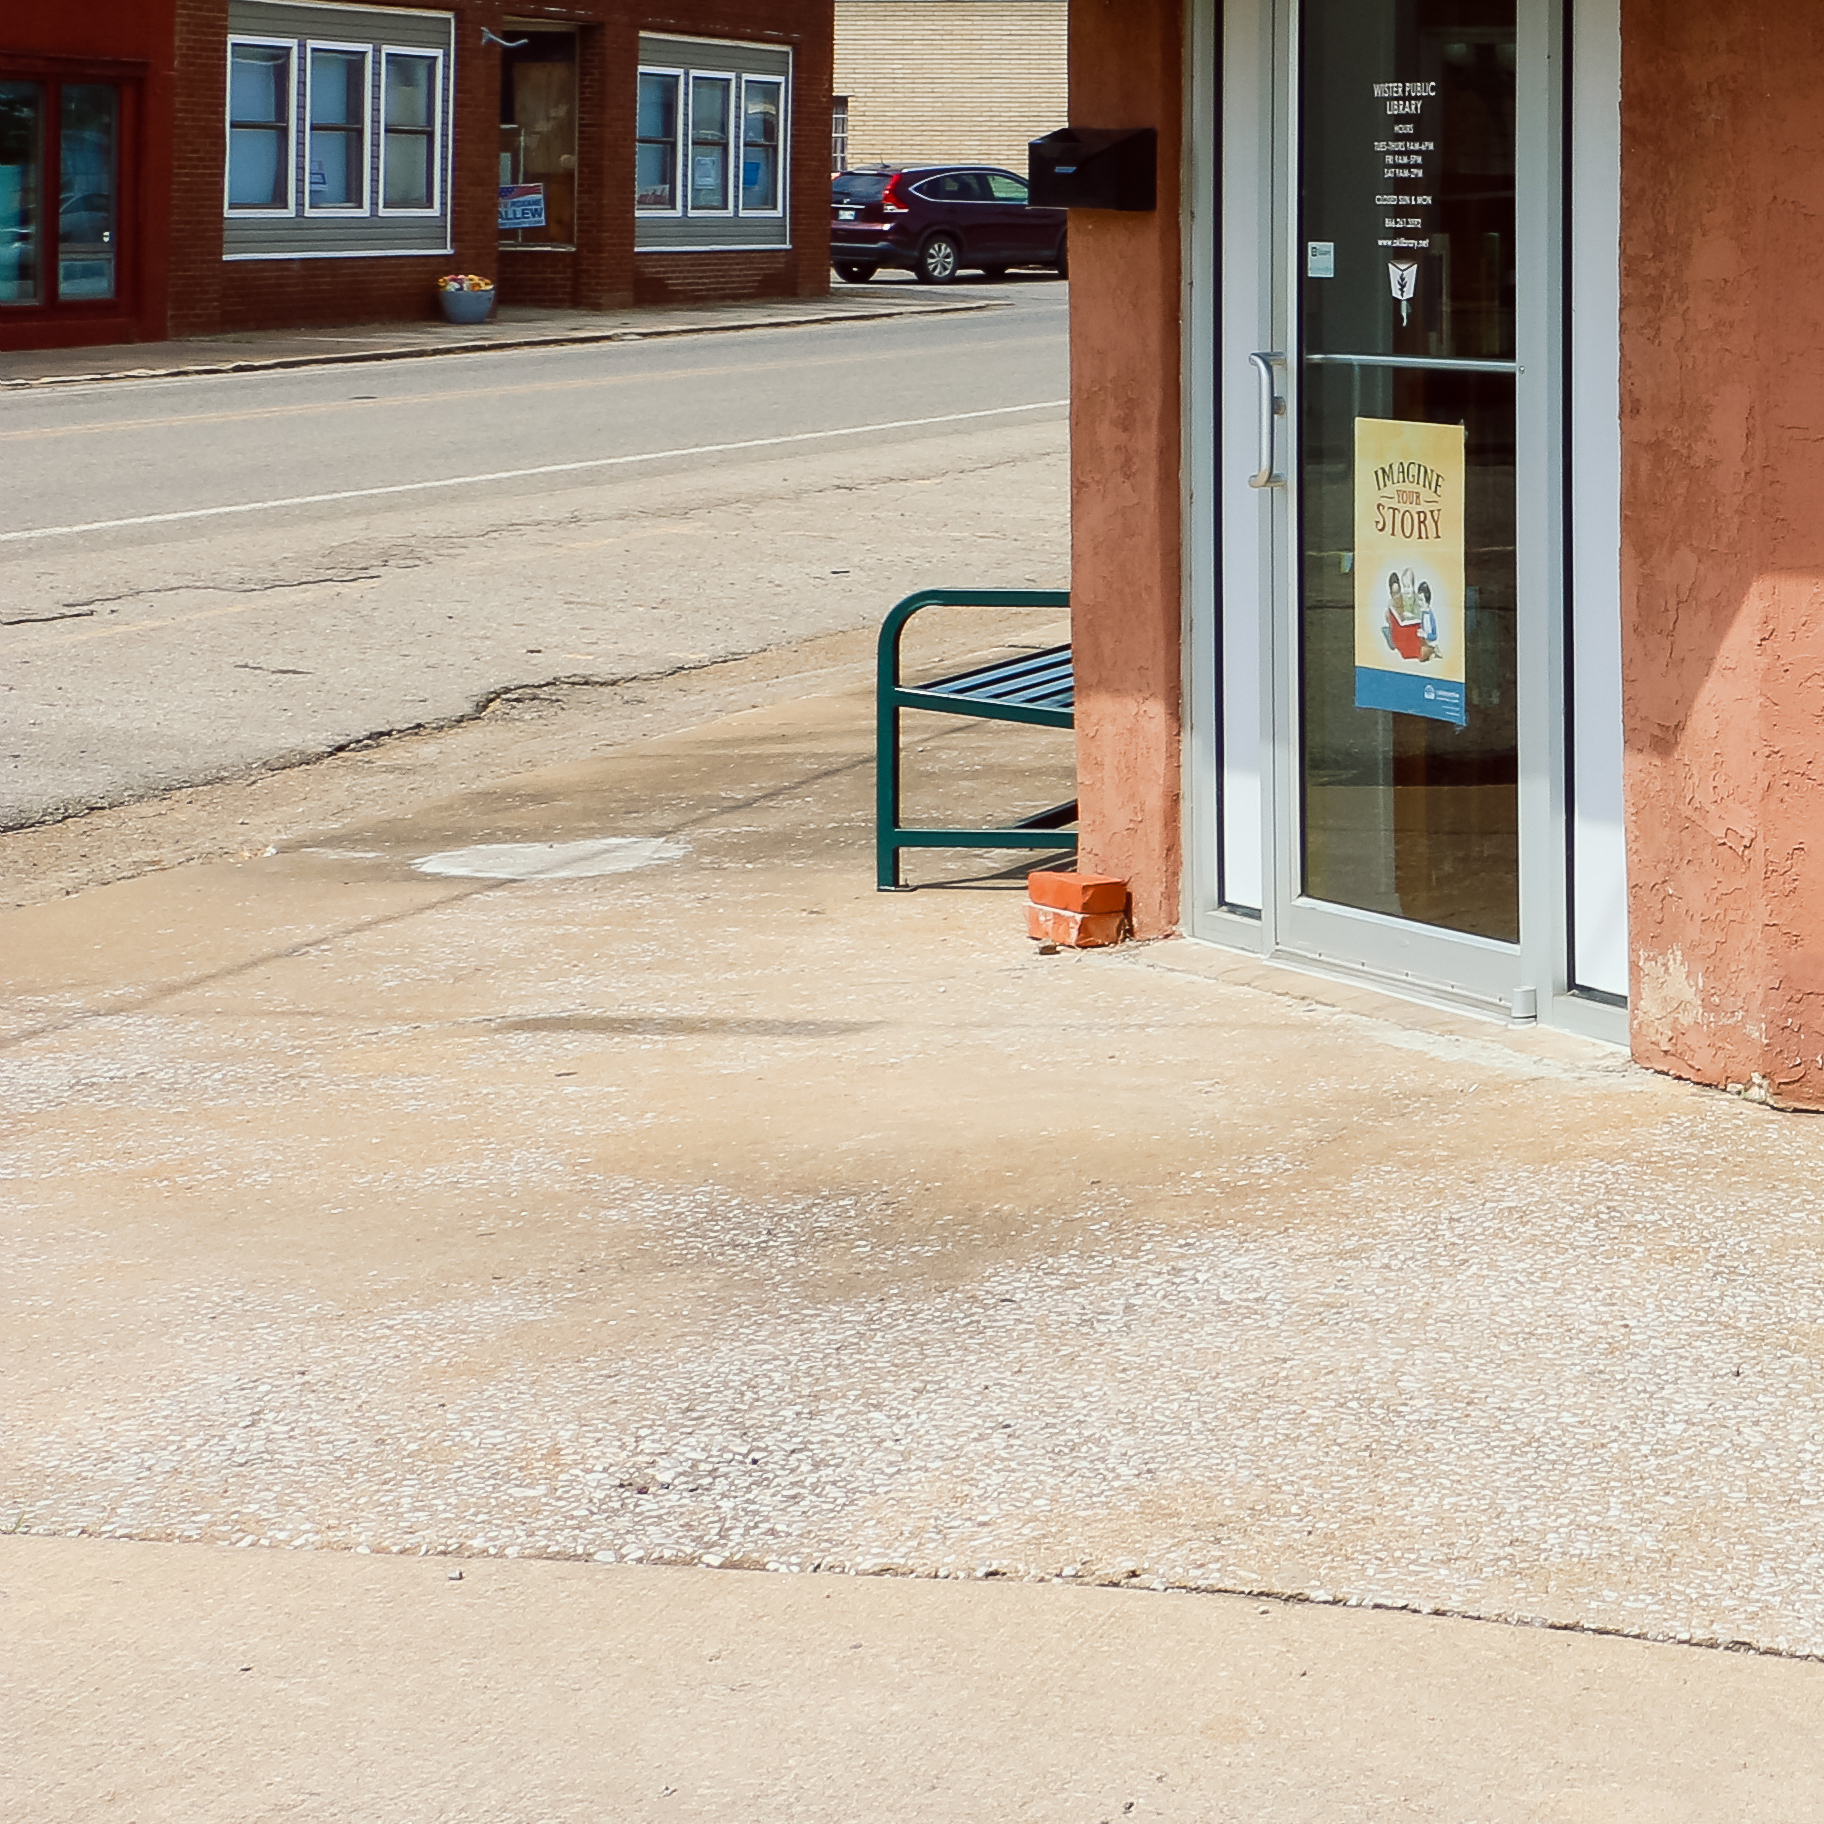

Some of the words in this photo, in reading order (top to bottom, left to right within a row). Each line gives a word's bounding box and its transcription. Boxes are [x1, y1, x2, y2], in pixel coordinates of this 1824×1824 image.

[1373, 82, 1403, 97] WISTER
[1405, 81, 1436, 96] PUBLIC
[1386, 100, 1422, 114] LIBRARY
[1374, 461, 1445, 497] IMAGINE
[1396, 489, 1421, 506] YOUR
[1374, 503, 1442, 539] STORY
